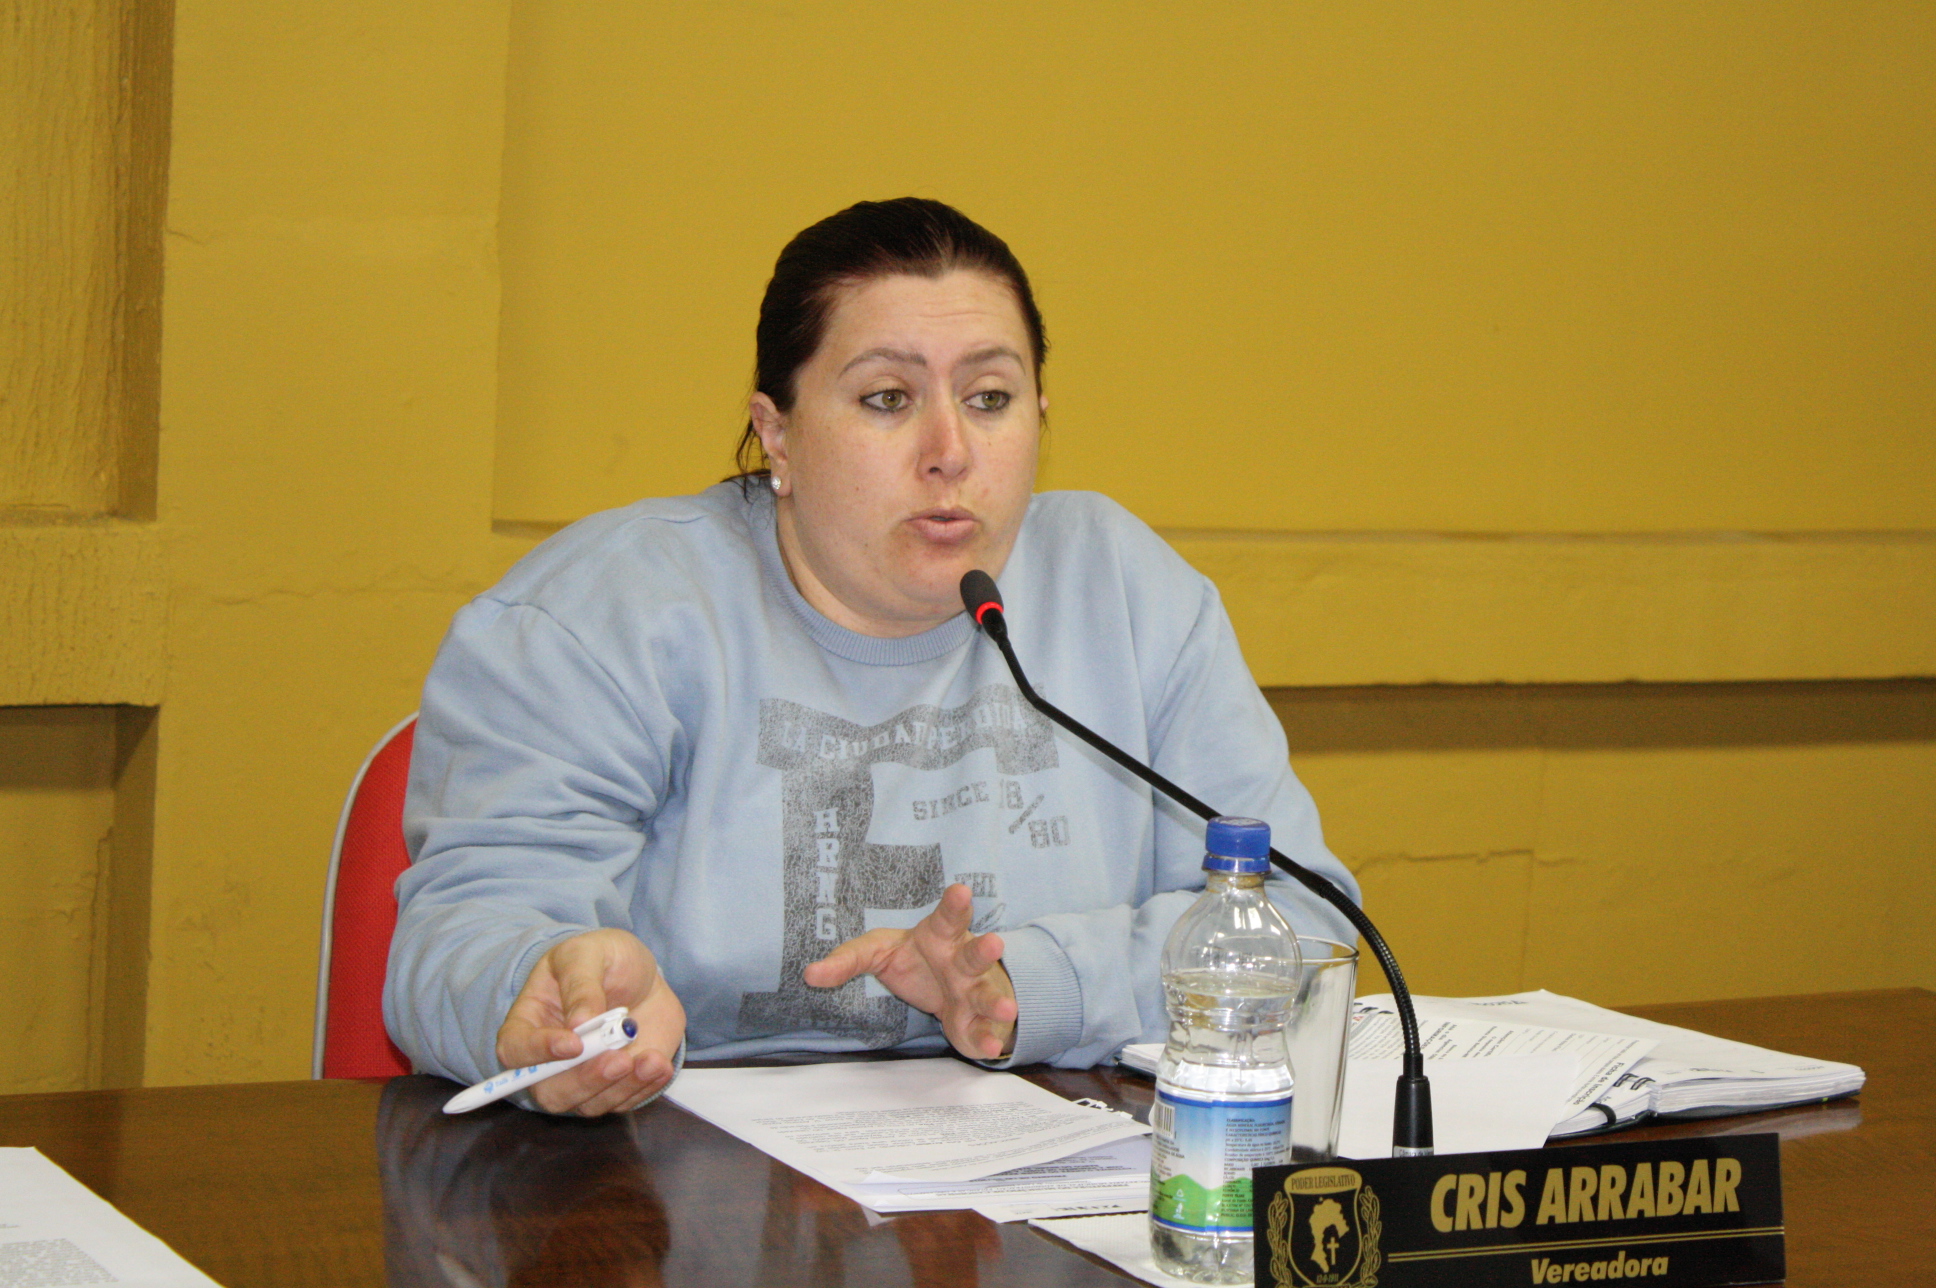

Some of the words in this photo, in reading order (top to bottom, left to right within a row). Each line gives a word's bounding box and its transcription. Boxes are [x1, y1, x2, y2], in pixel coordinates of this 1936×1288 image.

[912, 780, 990, 821] SINCE
[1291, 1176, 1313, 1190] PODER
[1314, 1173, 1356, 1189] LEGISLATIVO
[1430, 1169, 1527, 1233] CRIS
[1535, 1157, 1742, 1226] ARRABAR
[1531, 1250, 1670, 1285] Vereadora
